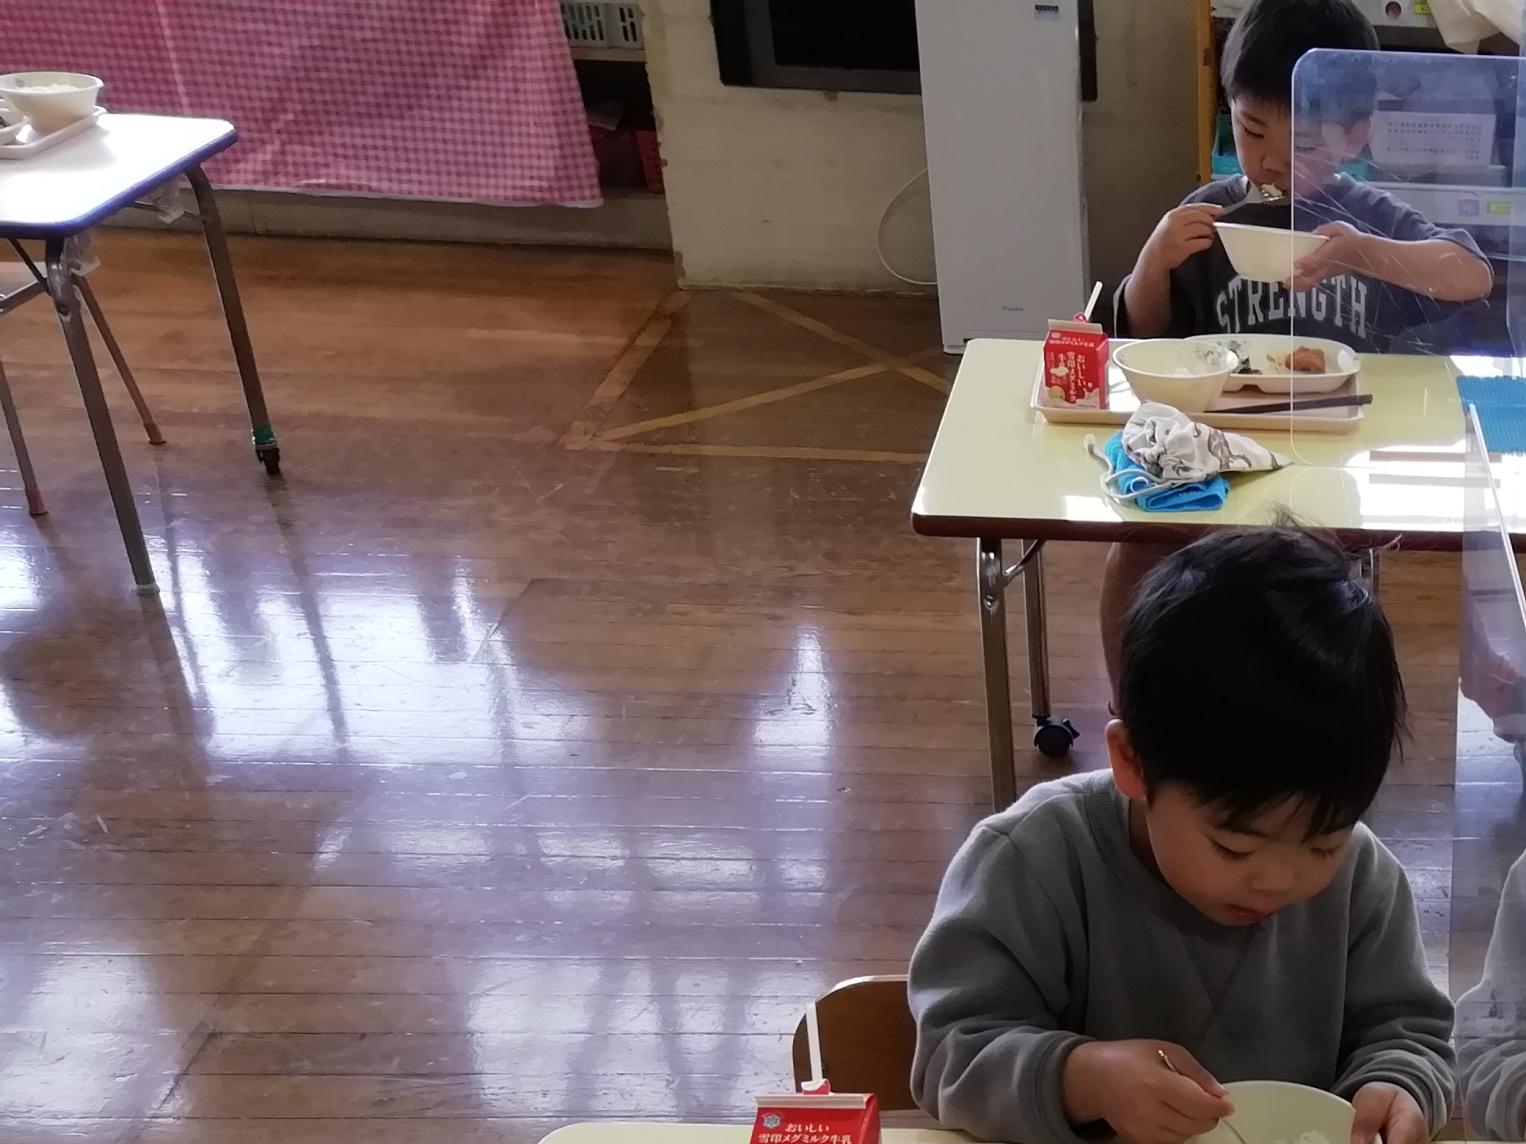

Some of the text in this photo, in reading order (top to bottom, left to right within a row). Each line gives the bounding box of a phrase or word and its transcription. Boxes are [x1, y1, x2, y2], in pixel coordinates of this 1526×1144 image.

[1216, 274, 1368, 339] STRENGTH
[785, 1122, 830, 1133] おいしい
[758, 1133, 852, 1144] 雪印メグミルク牛乳
